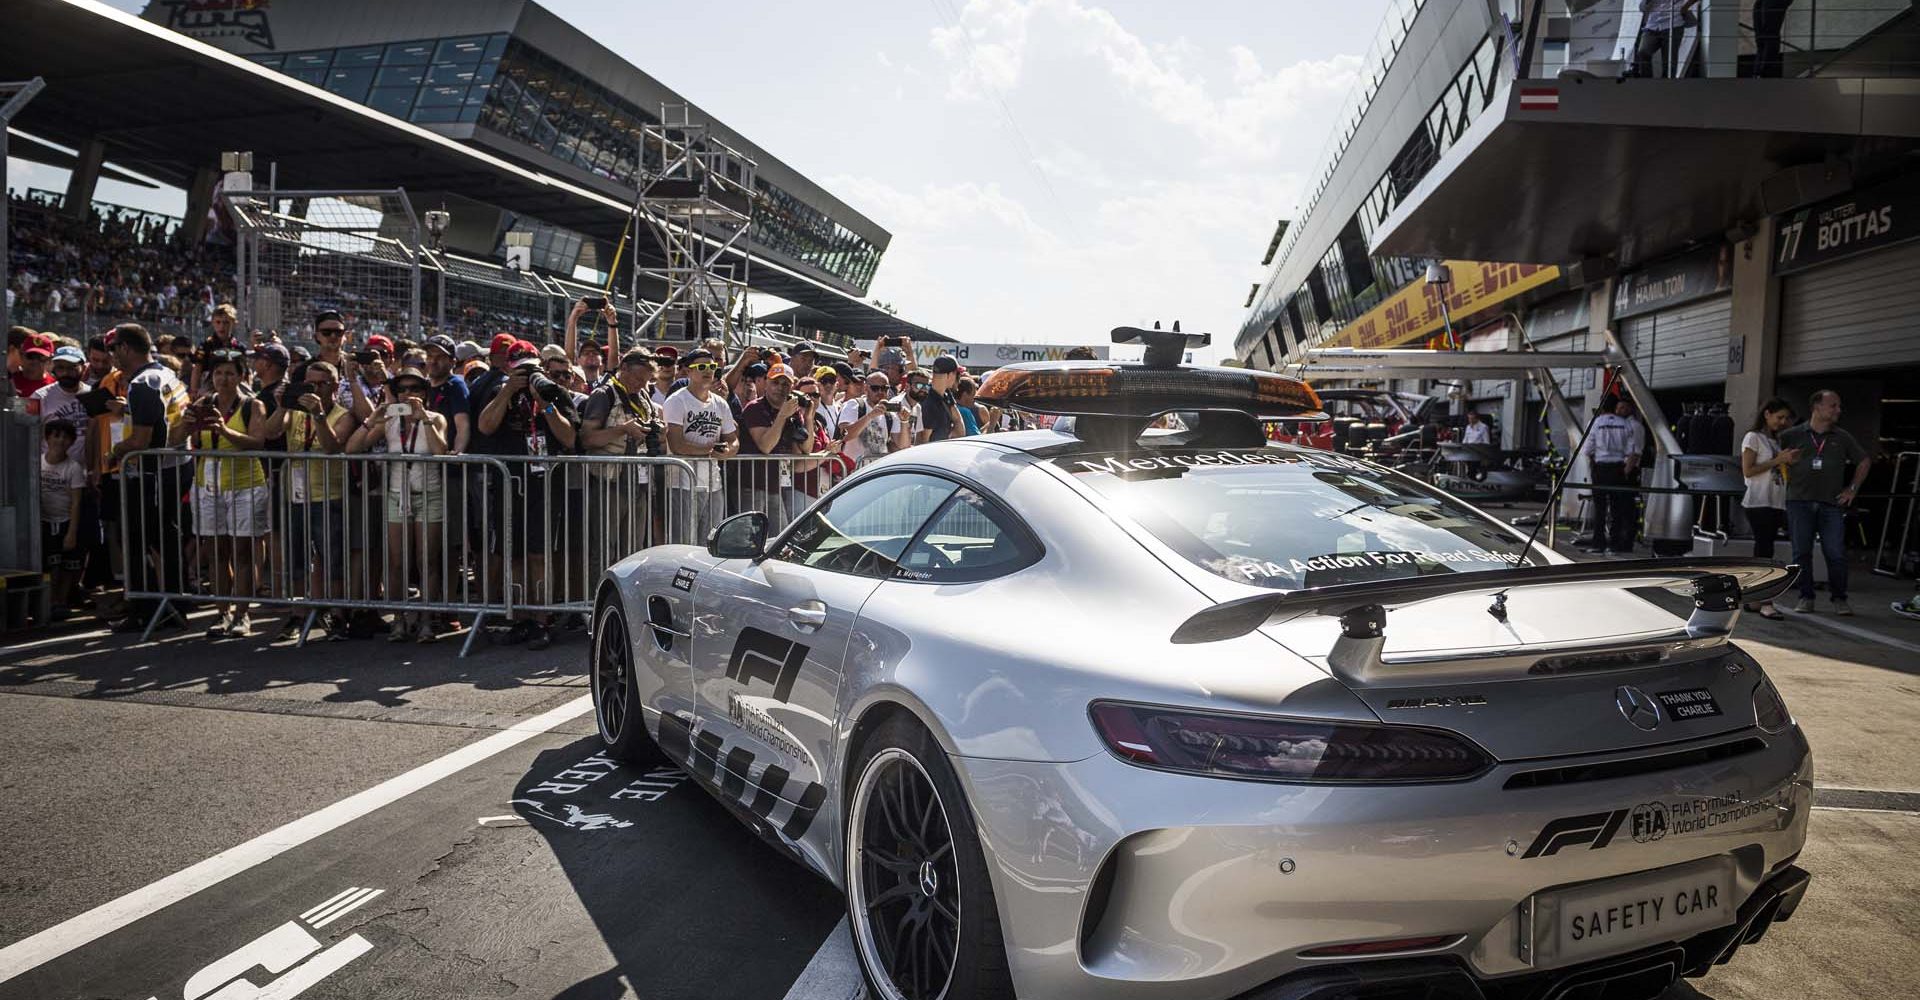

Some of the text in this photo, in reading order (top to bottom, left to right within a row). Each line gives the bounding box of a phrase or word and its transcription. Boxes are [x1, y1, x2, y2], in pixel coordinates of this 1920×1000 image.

[1778, 221, 1804, 264] 77
[1816, 205, 1892, 251] BOTTAS
[1635, 272, 1686, 305] HAMILTON
[915, 345, 969, 360] yWorld
[1237, 562, 1290, 580] FIA
[1290, 554, 1366, 573] Action
[1370, 551, 1416, 567] For
[1415, 549, 1471, 563] Road
[725, 626, 811, 705] F1
[1659, 690, 1712, 705] THANK YOU
[1676, 703, 1715, 717] CHARLIE
[745, 720, 808, 764] World Championship
[525, 750, 621, 795] KER
[1671, 803, 1691, 818] FIA
[1672, 798, 1772, 835] World Championship
[1520, 808, 1631, 860] F1
[1571, 884, 1719, 941] SAFETY CAR
